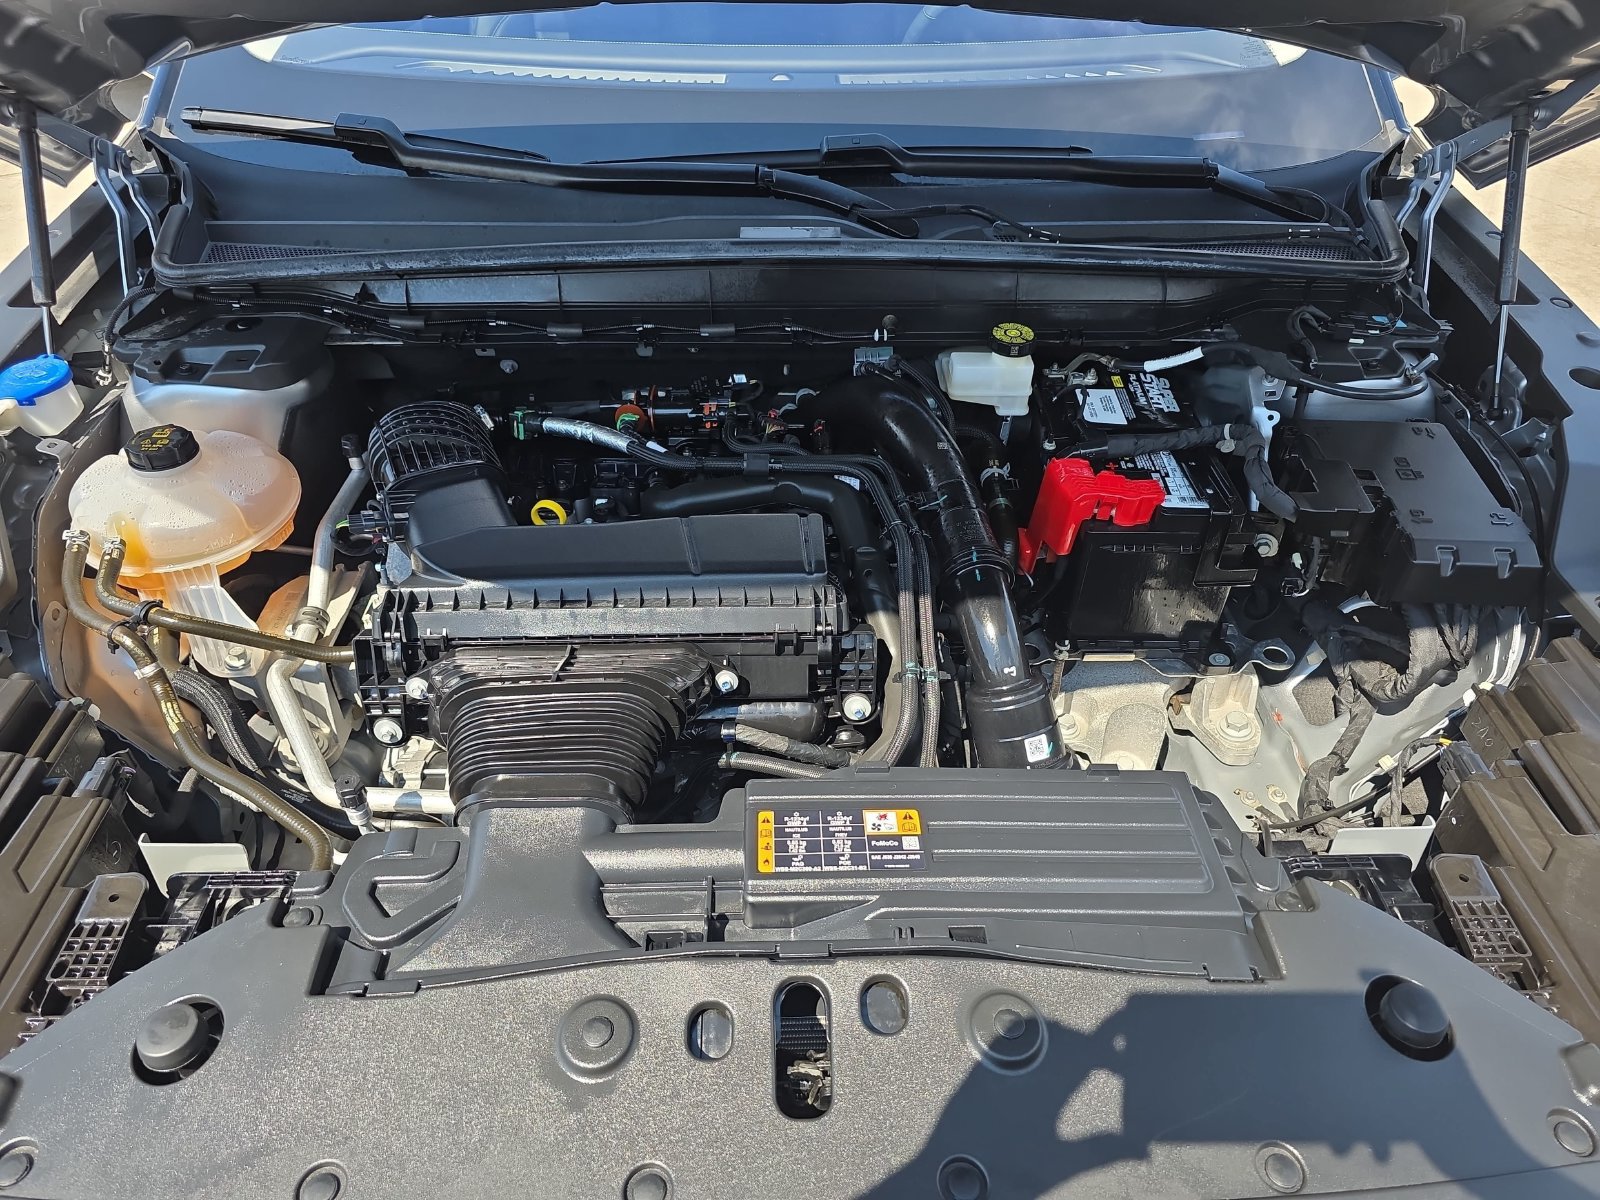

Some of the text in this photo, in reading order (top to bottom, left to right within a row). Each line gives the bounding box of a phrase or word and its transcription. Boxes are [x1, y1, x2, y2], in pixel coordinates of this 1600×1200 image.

[1128, 373, 1148, 405] PLATINUM
[1140, 372, 1169, 412] START
[1156, 377, 1180, 413] SUPER
